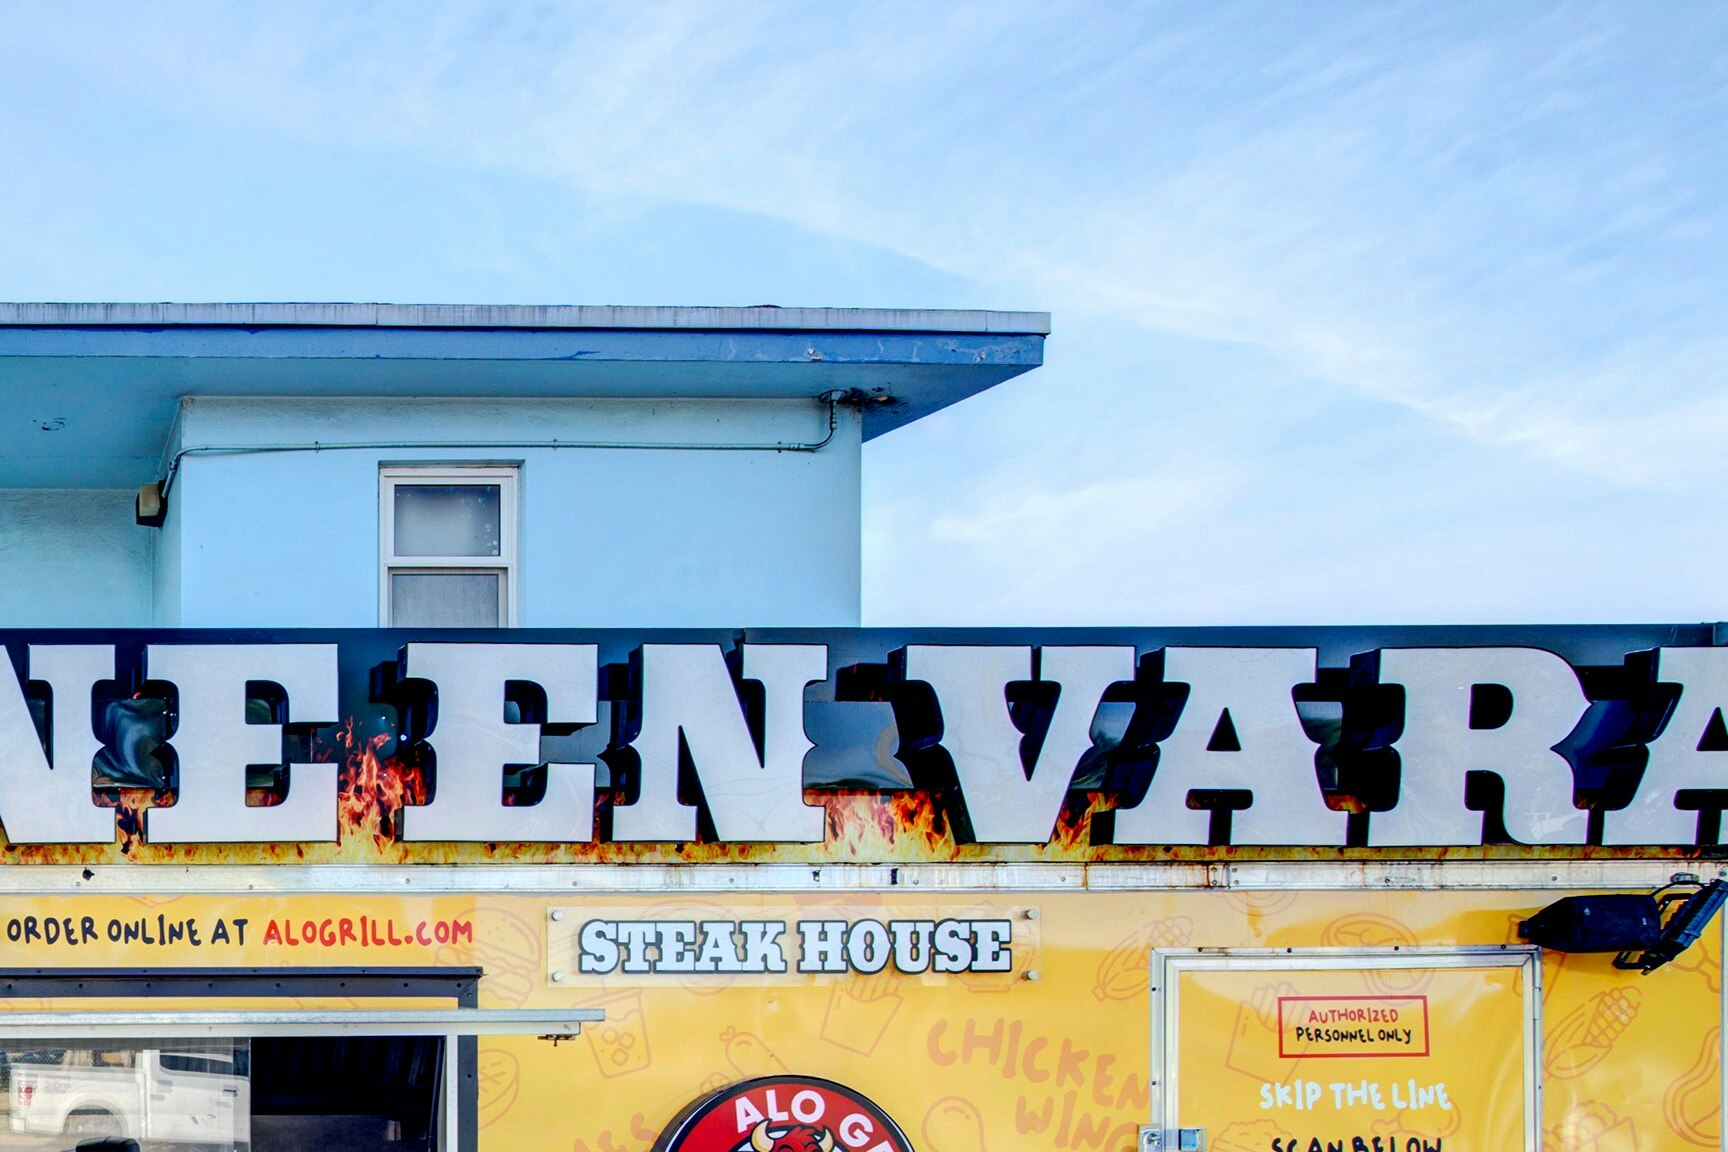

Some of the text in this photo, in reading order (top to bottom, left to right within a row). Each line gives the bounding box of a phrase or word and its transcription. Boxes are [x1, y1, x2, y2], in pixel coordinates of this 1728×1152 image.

[401, 642, 828, 846] EN
[905, 645, 1728, 848] VARA
[6, 914, 473, 948] ORDER ONLINE AT ALOGRILL.COM
[578, 919, 1013, 975] STEAK HOUSE
[1308, 1007, 1399, 1025] AUTHORIZED
[1296, 1027, 1412, 1046] PERSONNEL ONLY
[927, 1018, 1150, 1110] CHICKEN
[733, 1087, 825, 1134] ALO
[1259, 1079, 1452, 1110] SKIP THE LINE
